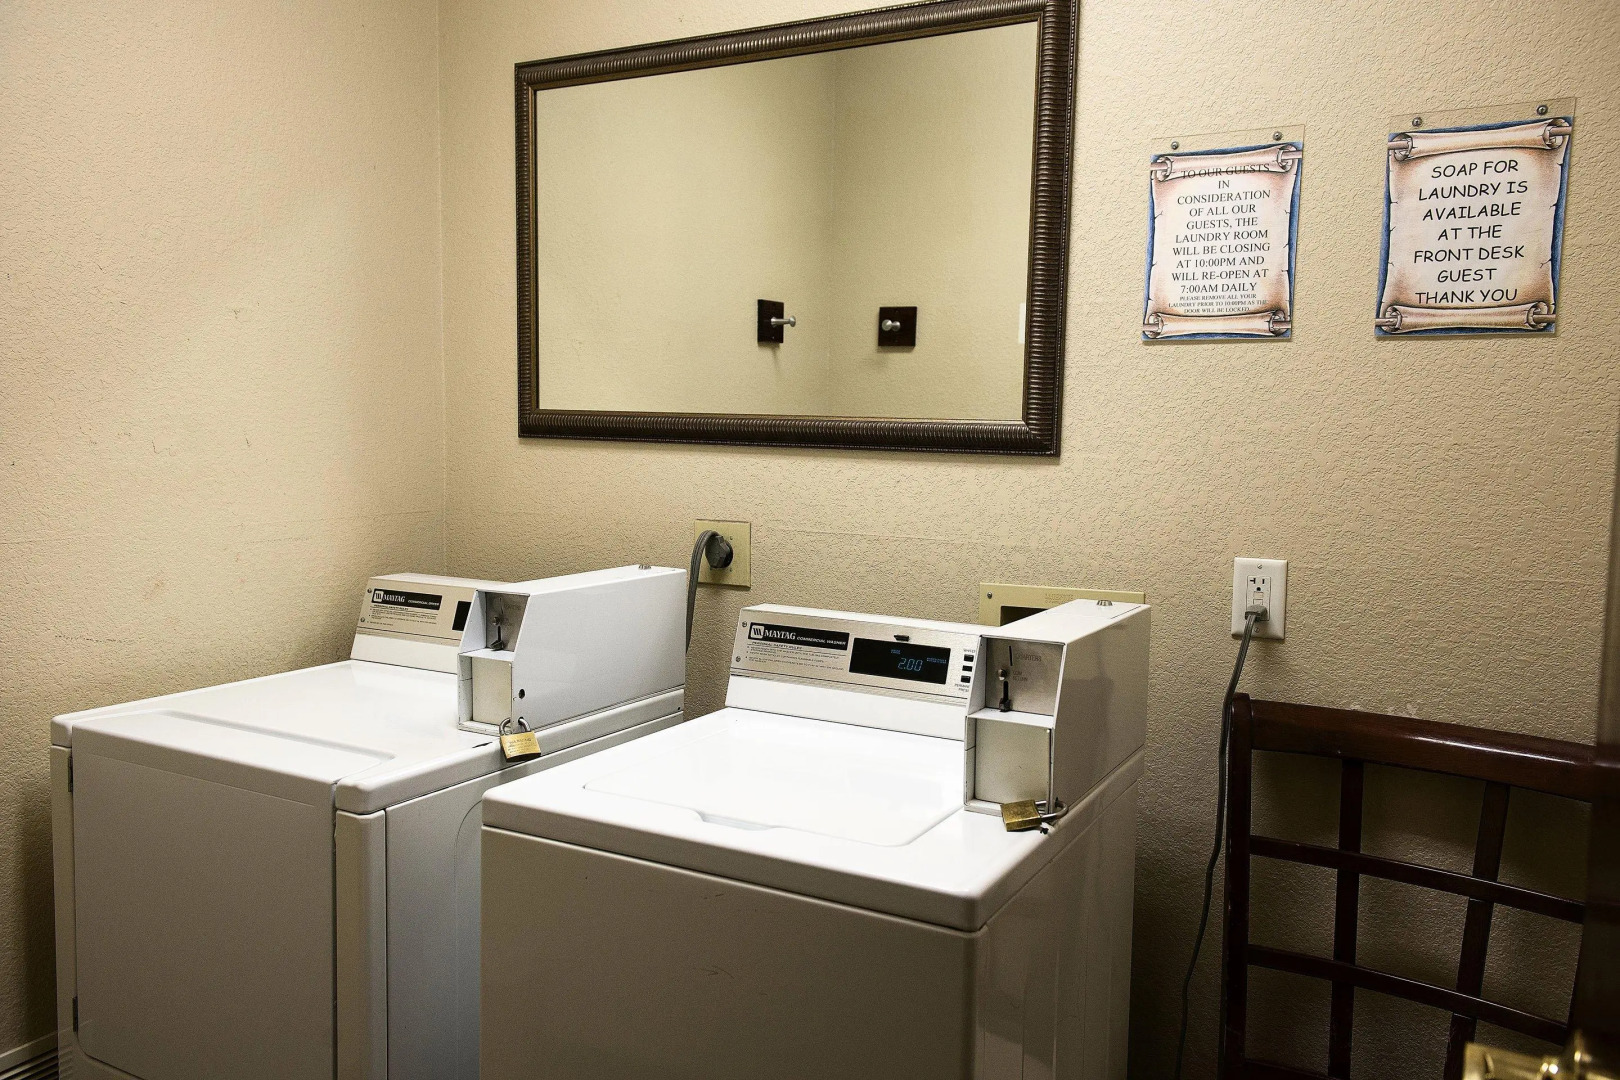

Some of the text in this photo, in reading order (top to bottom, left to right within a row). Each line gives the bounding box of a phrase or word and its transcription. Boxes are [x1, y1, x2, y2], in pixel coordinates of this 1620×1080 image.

[1181, 164, 1269, 179] TO OUR GUESTS
[1432, 160, 1518, 178] SOAP FOR
[1218, 180, 1230, 189] IN
[1418, 181, 1527, 200] LAUNDRY IS
[1177, 190, 1271, 204] CONSIDERATION
[1190, 204, 1256, 216] OF ALL OUR
[1423, 202, 1521, 220] AVAILABLE
[1187, 217, 1258, 230] GUESTS, THE
[1176, 230, 1268, 243] LAUNDRY ROOM
[1438, 224, 1502, 241] AT THE
[1173, 243, 1270, 256] WILL BE CLOSING
[1414, 245, 1524, 263] FRONT DESK
[1176, 256, 1264, 268] AT 10:00PM AND
[1172, 269, 1269, 281] WILL RE-OPEN AT
[1437, 268, 1497, 282] GUEST
[1181, 282, 1257, 293] 7:00AM DAILY
[1415, 289, 1518, 304] THANK YOU
[764, 629, 796, 640] MAYTAG
[898, 657, 923, 671] 2.00
